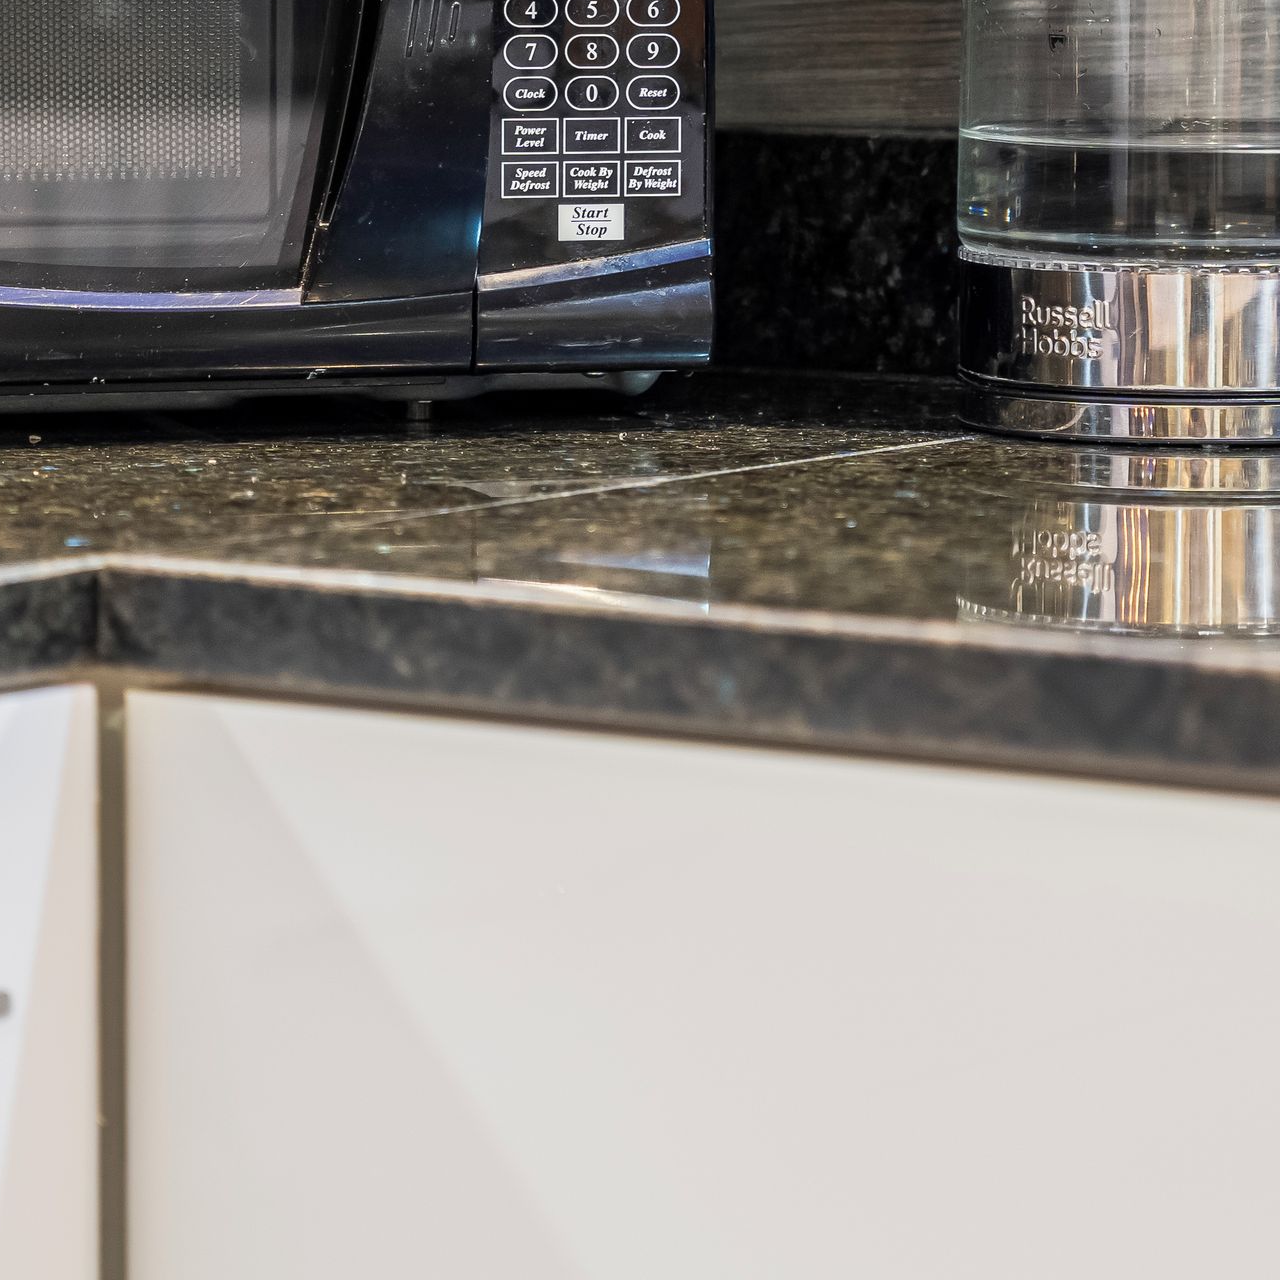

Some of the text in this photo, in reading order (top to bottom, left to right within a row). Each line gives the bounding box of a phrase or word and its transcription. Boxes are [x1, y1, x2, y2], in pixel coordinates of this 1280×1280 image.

[525, 1, 538, 20] 4
[586, 0, 598, 19] 5
[647, 0, 660, 19] 6
[525, 43, 537, 61] 7
[586, 42, 598, 61] 8
[647, 41, 659, 60] 9
[515, 89, 546, 99] Clock
[585, 83, 598, 103] 0
[639, 87, 668, 97] Reset
[514, 125, 547, 136] Power
[574, 130, 609, 141] Timer
[639, 129, 667, 140] Cook
[515, 137, 545, 148] Level
[515, 167, 547, 180] Speed
[569, 166, 614, 179] Cook By
[633, 165, 672, 177] Defrost
[510, 180, 551, 192] Defrost
[573, 179, 609, 191] Weight
[628, 178, 678, 191] By Weight
[572, 206, 609, 219] Start
[576, 223, 608, 238] Stop
[1020, 295, 1112, 329] Russell
[1021, 327, 1104, 359] Hobbs
